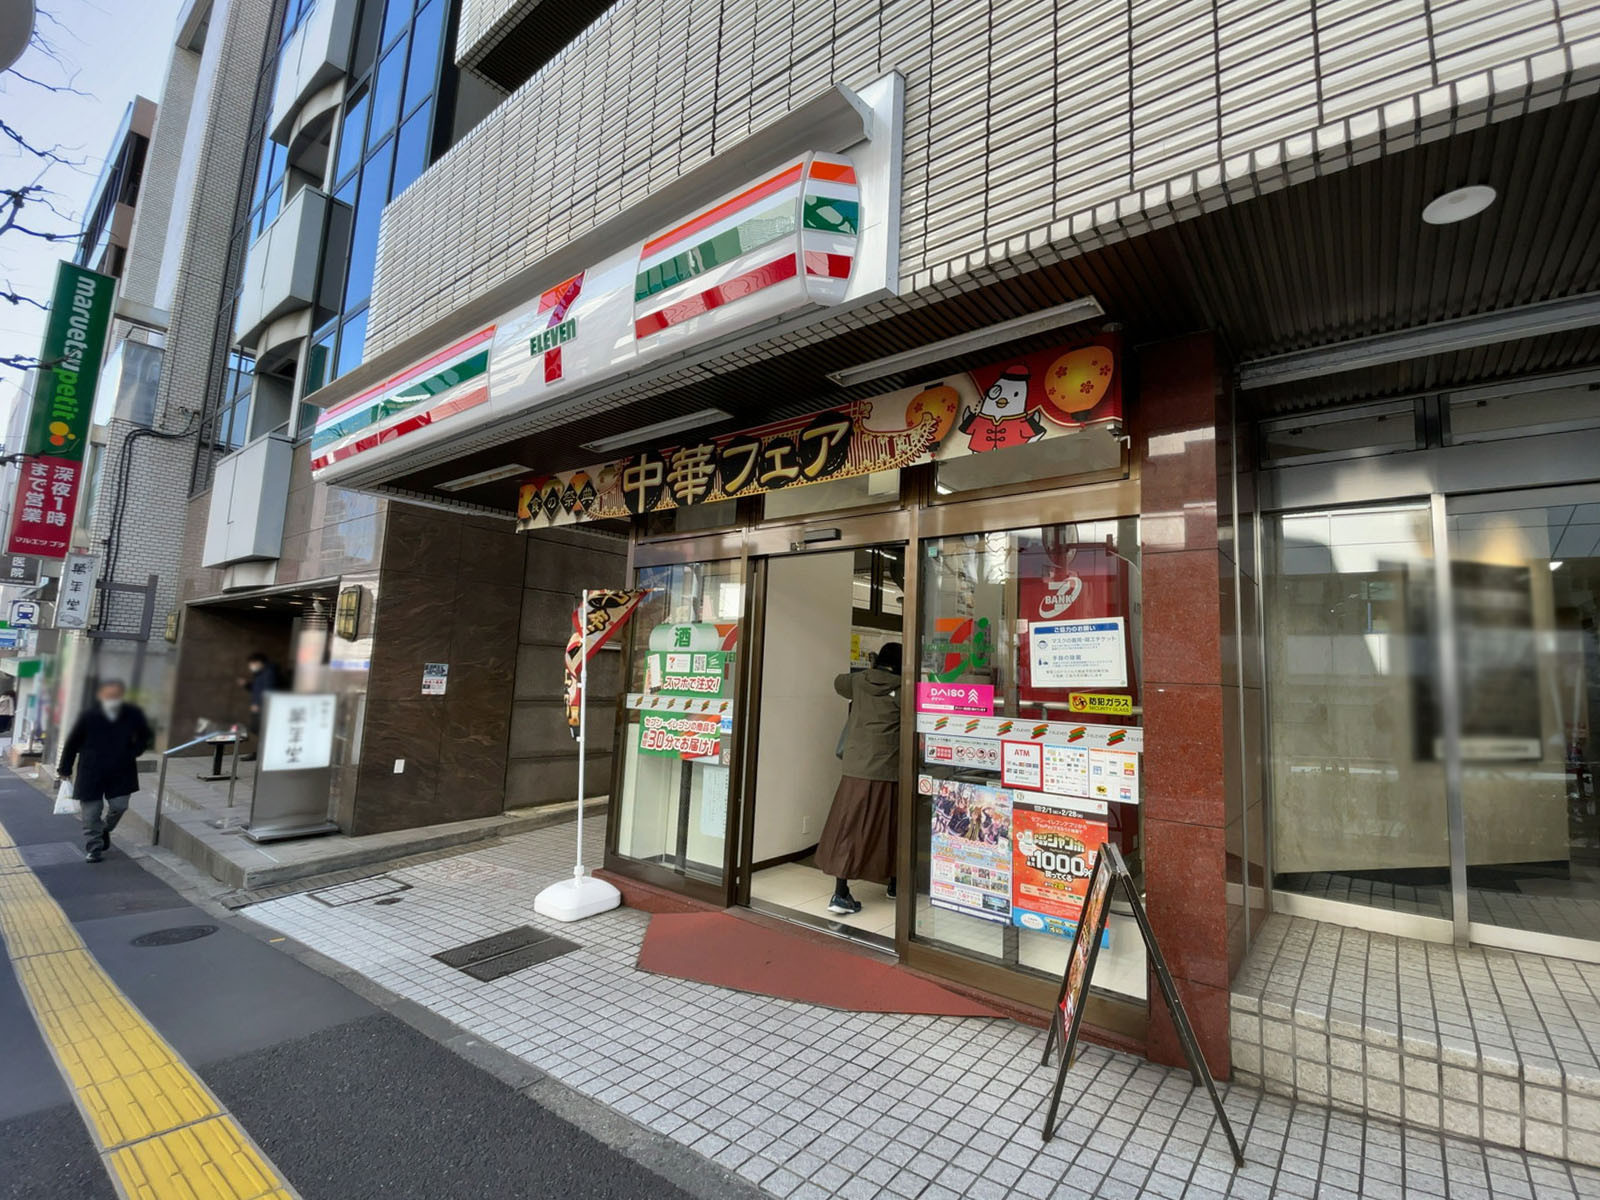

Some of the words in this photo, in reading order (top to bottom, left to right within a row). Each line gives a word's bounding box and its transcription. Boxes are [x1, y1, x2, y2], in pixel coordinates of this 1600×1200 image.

[537, 269, 586, 385] 7
[622, 420, 852, 513] 中華フェア
[21, 462, 50, 524] まで営業
[47, 465, 75, 527] 深夜1時
[1045, 594, 1073, 606] BANK
[674, 626, 692, 648] 酒
[1088, 696, 1130, 708] 防犯ガラス
[1013, 748, 1031, 758] ATM
